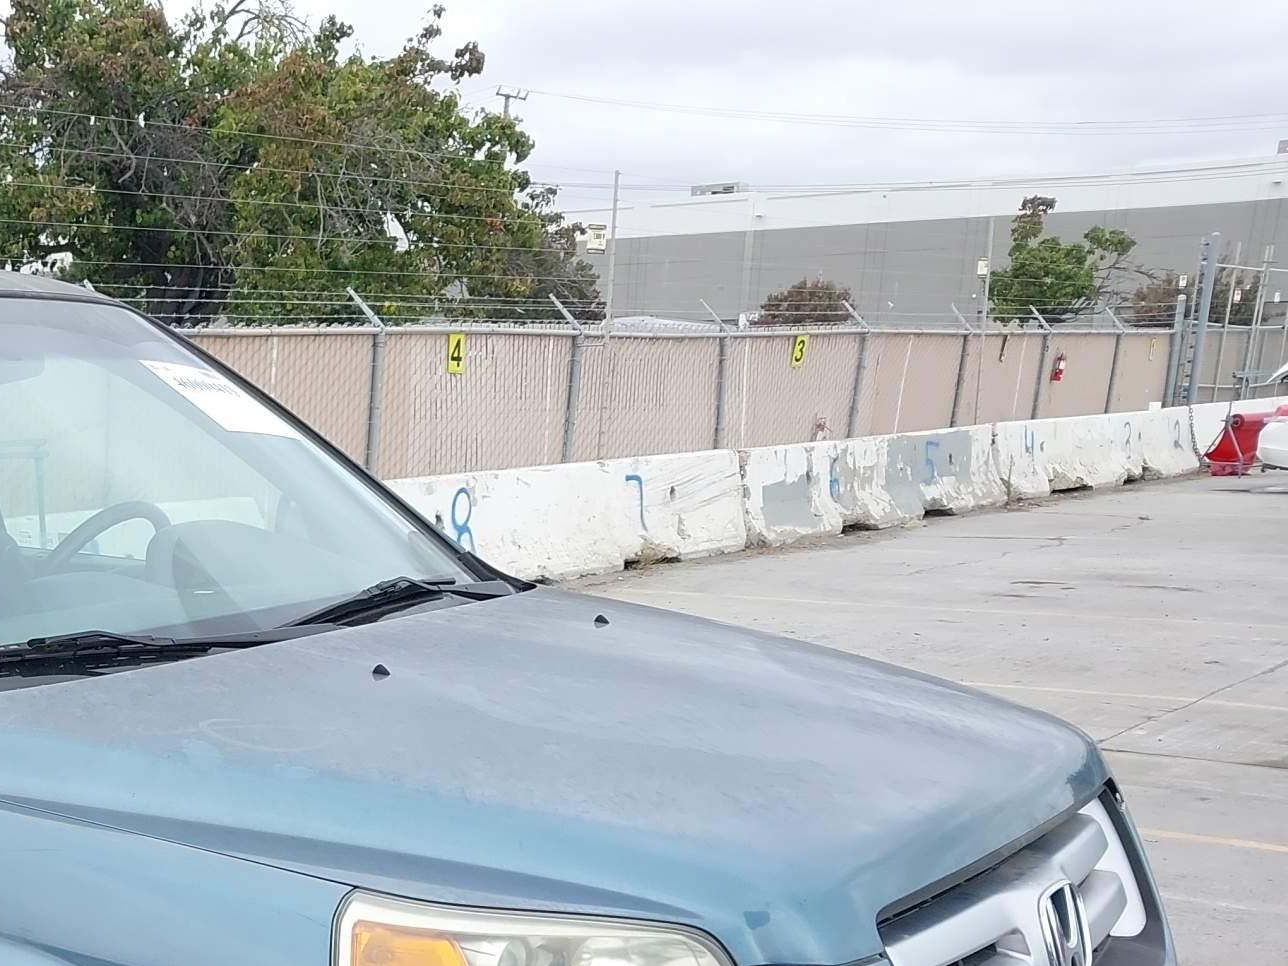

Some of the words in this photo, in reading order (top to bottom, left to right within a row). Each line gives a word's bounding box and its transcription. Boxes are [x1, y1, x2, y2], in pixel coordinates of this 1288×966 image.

[451, 338, 462, 367] 4
[795, 340, 806, 362] 3
[924, 441, 939, 486] 5
[451, 487, 476, 554] 8
[625, 475, 648, 533] 7
